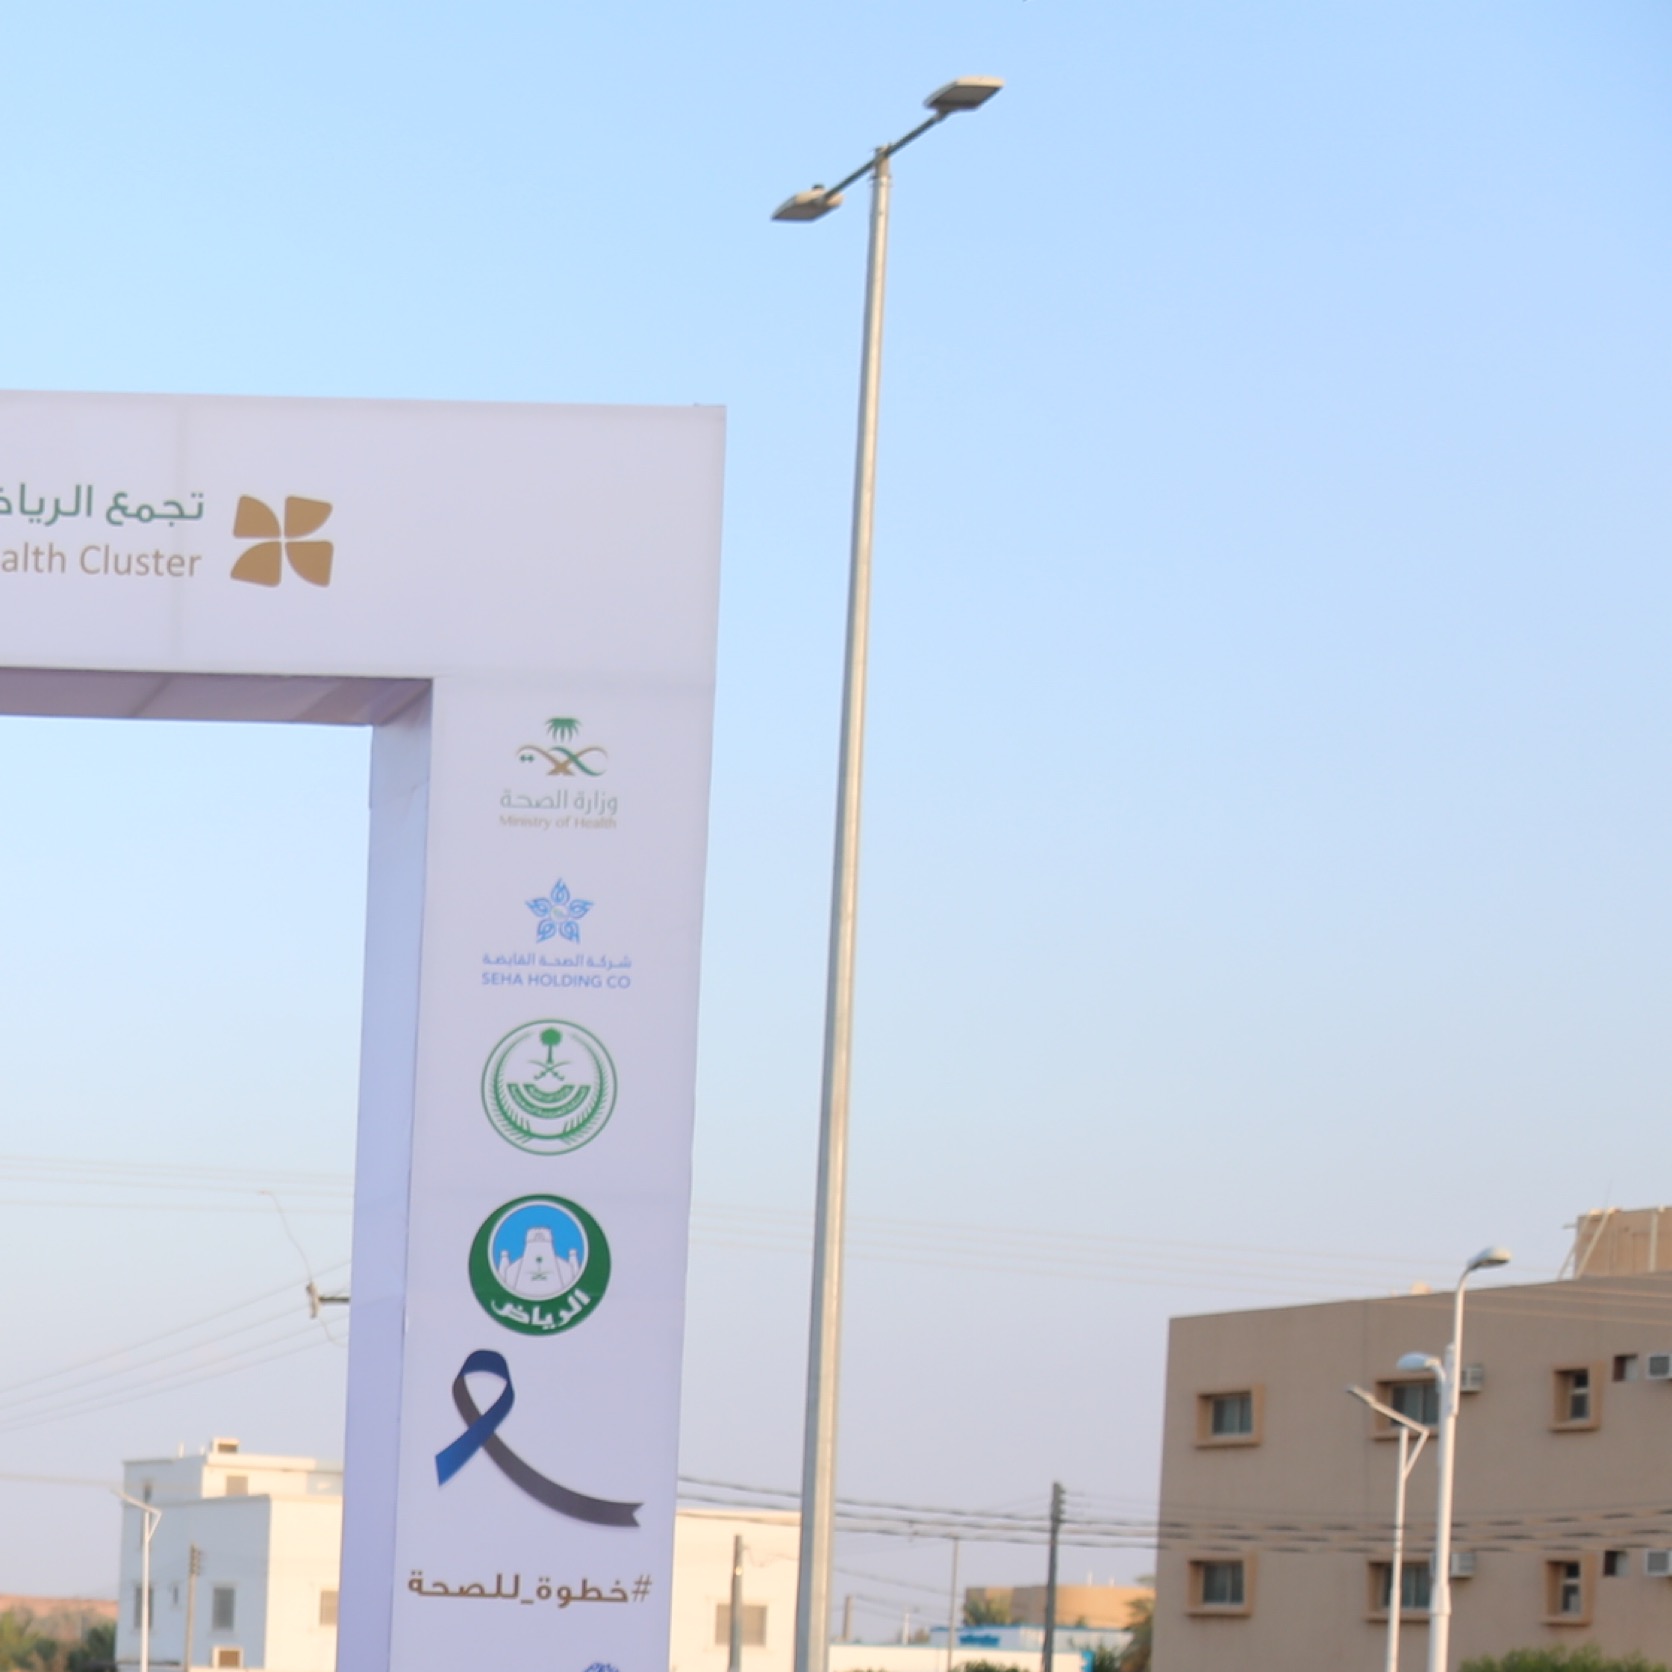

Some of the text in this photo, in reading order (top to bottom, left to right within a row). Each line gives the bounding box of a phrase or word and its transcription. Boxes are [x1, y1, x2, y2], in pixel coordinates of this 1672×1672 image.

[106, 491, 205, 527] تجمع
[80, 543, 202, 578] Cluster
[500, 788, 618, 815] وزارة الصحة
[481, 971, 631, 990] SEHA HOLDING CO
[490, 1287, 591, 1331] الرياض
[407, 1569, 653, 1608] #خطوة_للصحة
